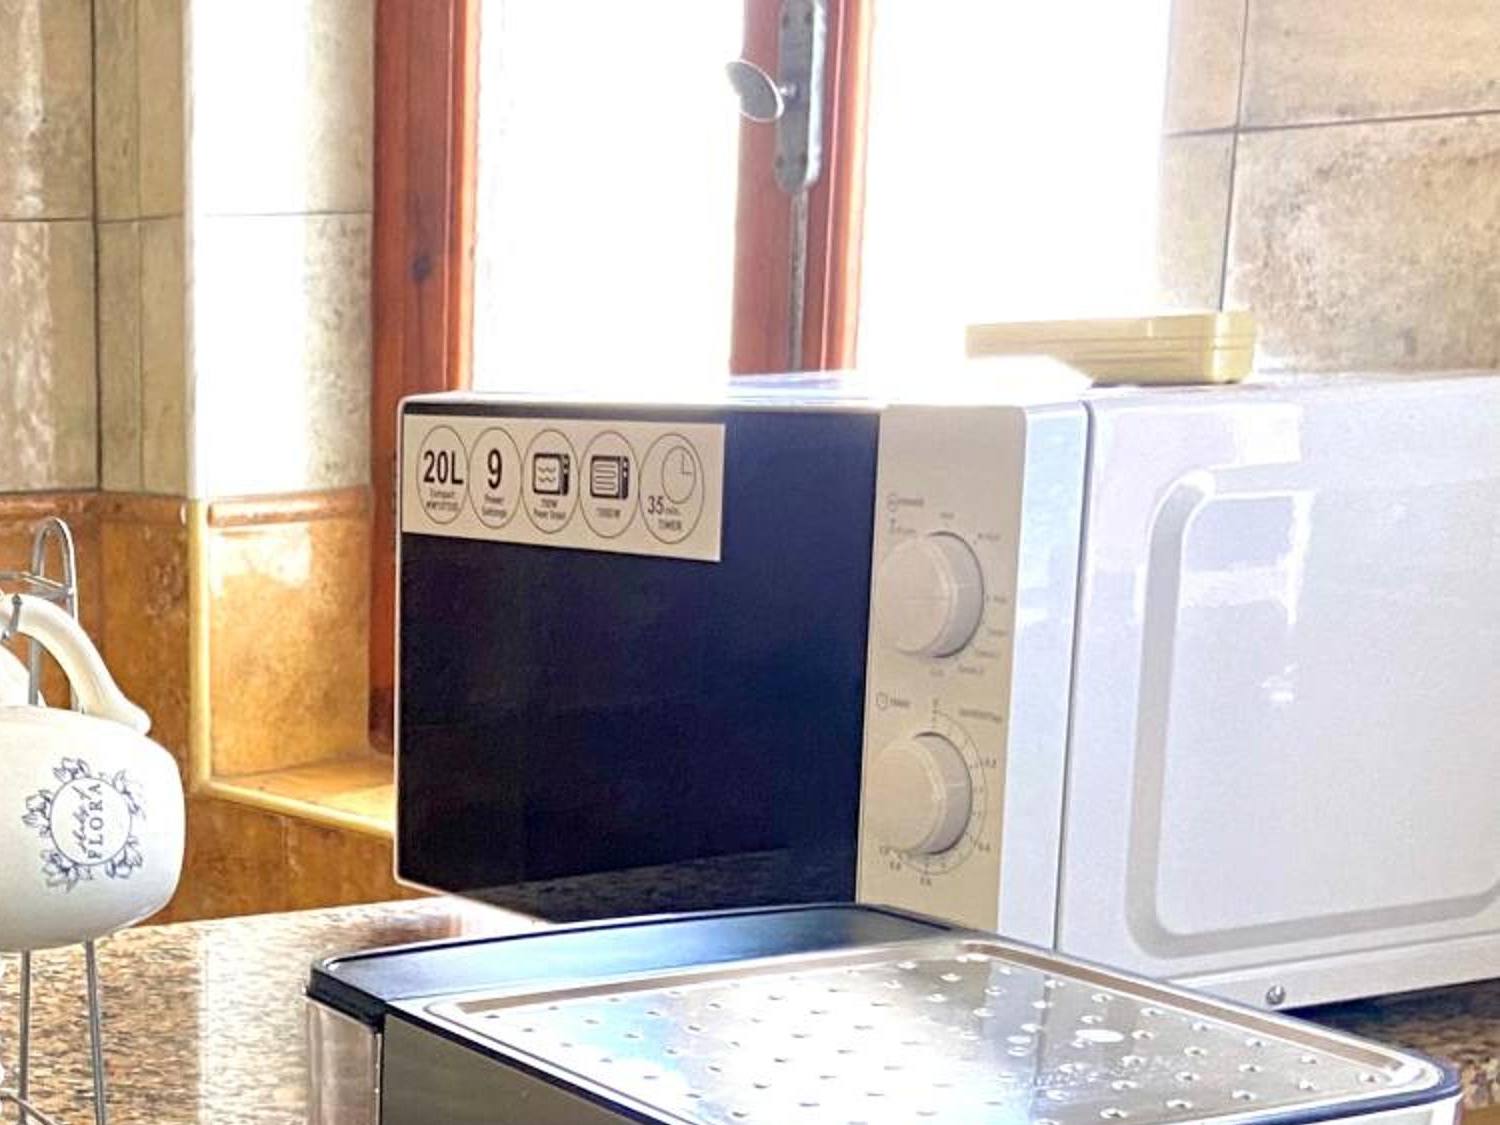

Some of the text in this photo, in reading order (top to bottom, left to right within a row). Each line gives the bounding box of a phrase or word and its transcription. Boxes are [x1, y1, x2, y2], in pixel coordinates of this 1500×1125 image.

[423, 449, 464, 485] 20L
[486, 448, 503, 489] 9
[647, 496, 664, 515] 35
[87, 784, 105, 860] FLORA
